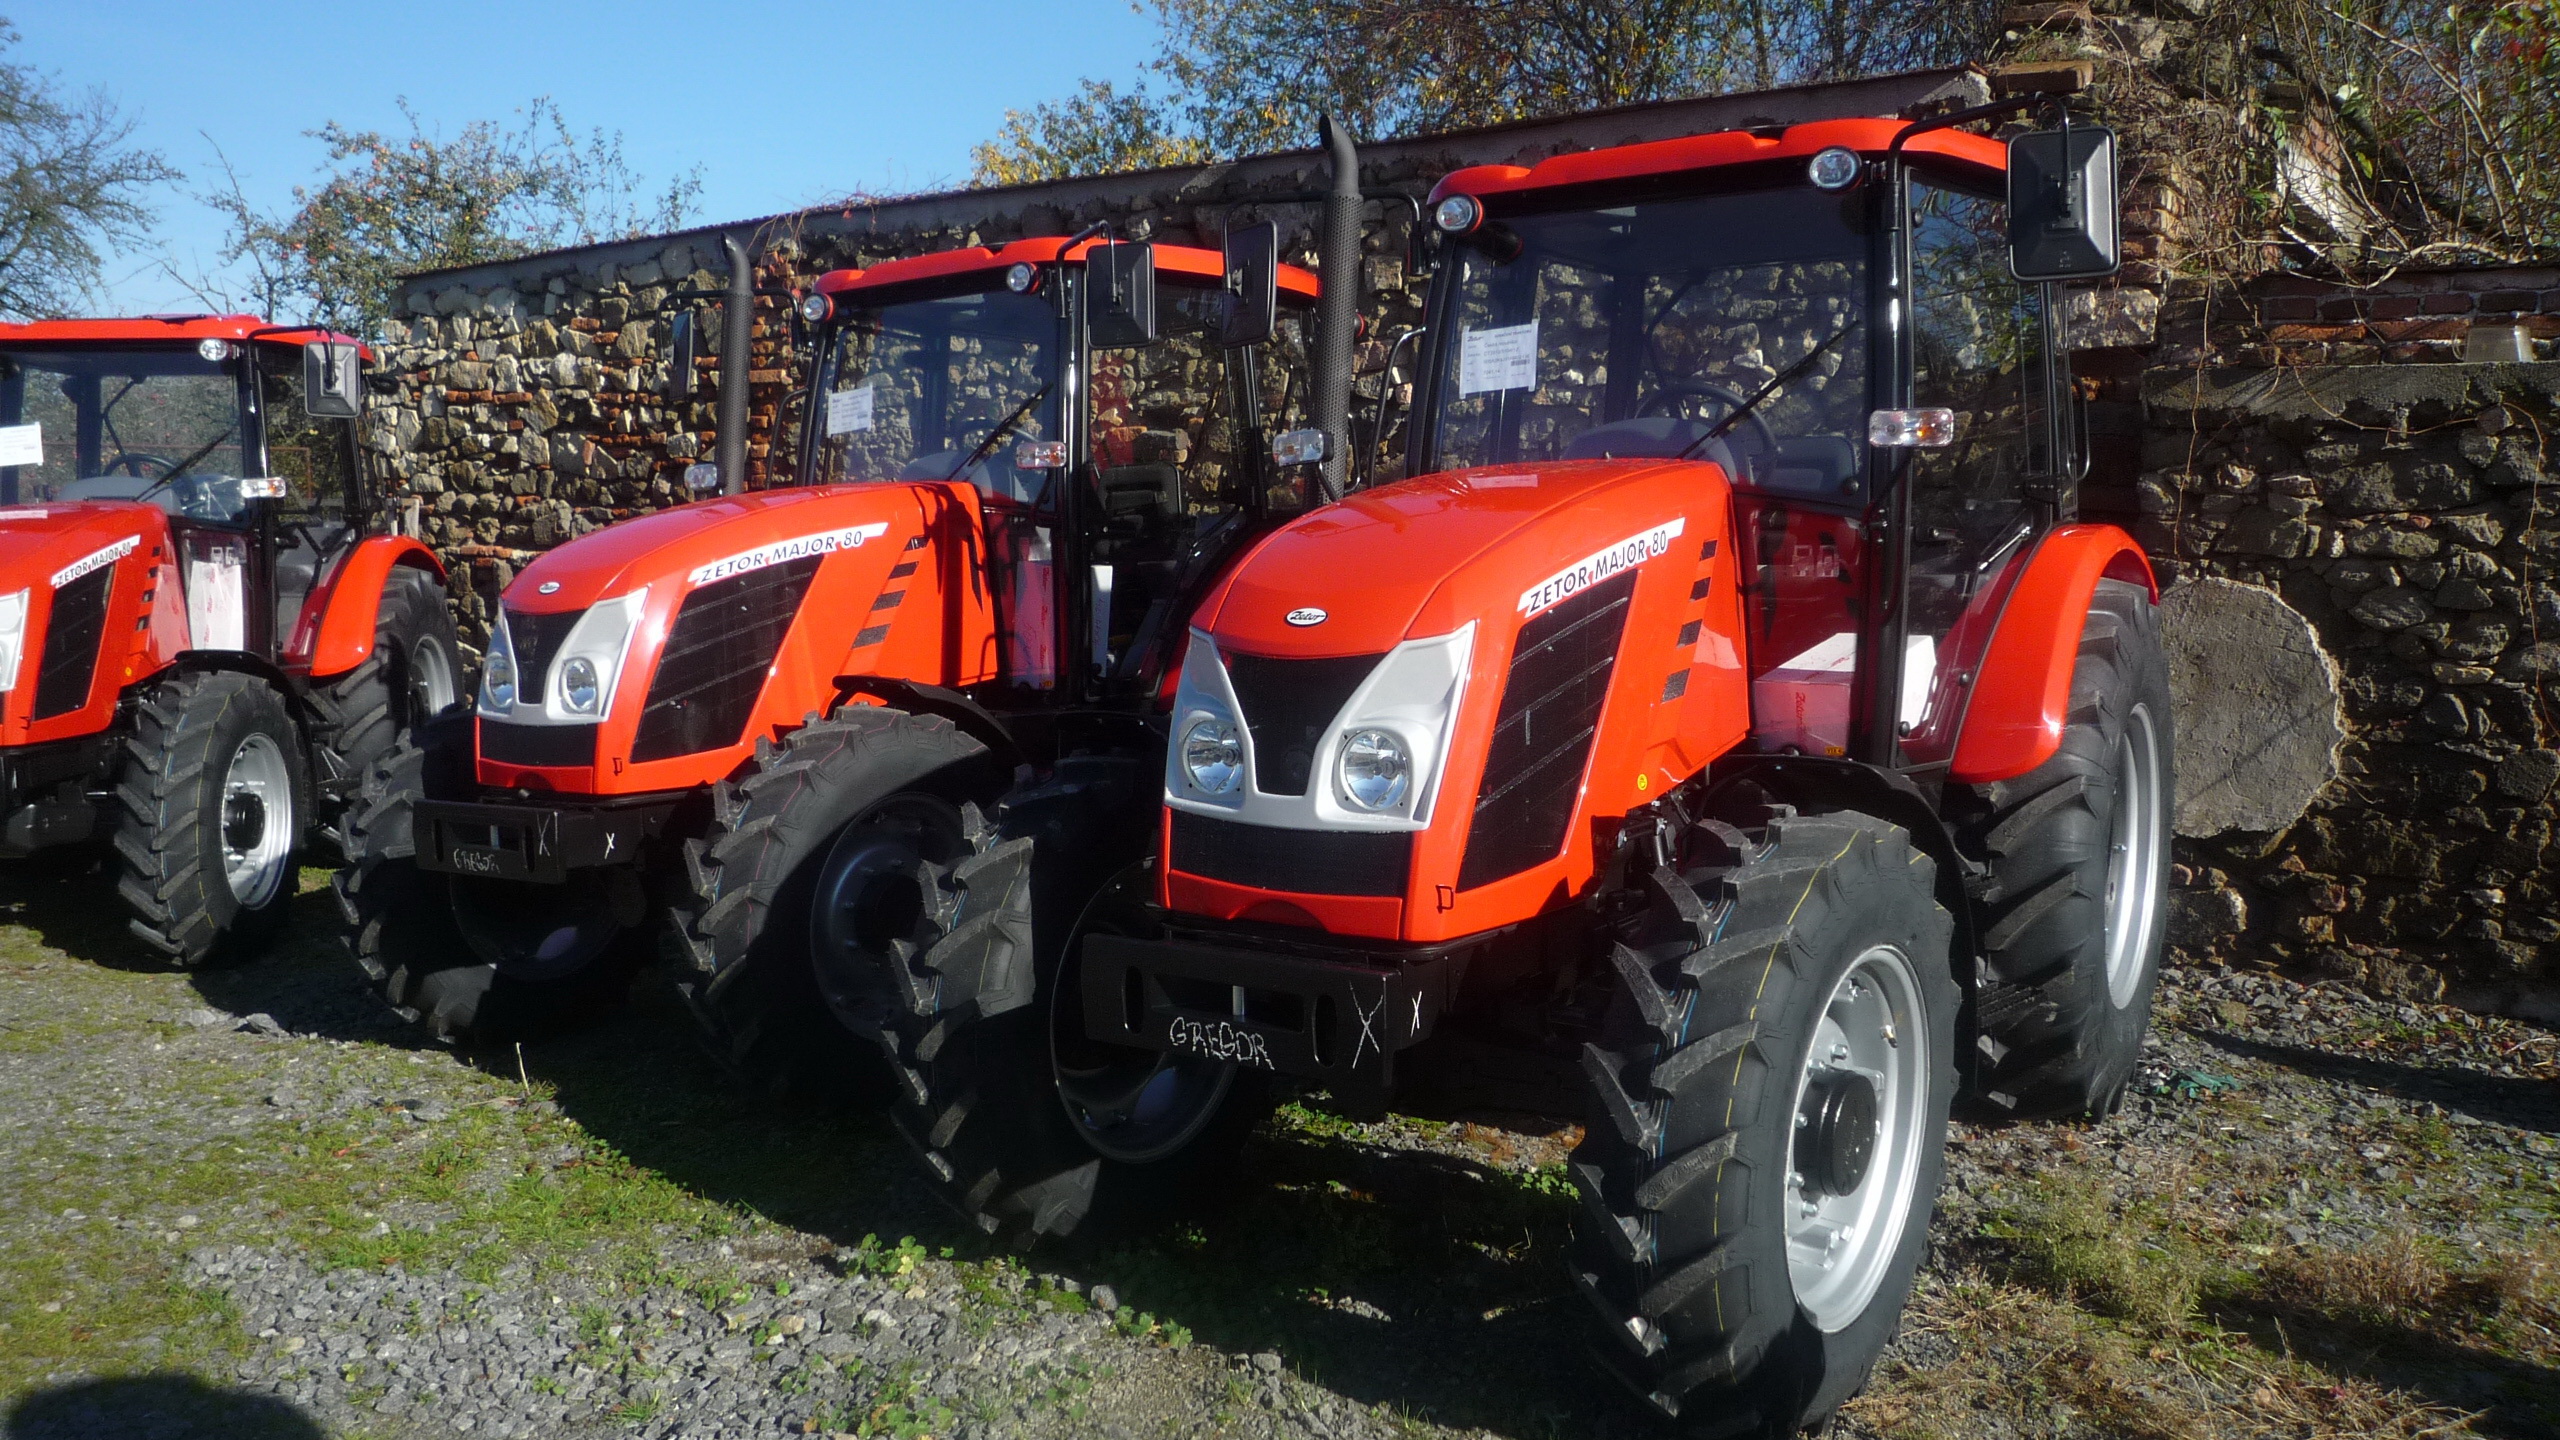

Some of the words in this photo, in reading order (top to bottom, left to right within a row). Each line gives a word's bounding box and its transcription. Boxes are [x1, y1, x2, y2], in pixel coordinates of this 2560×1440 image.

[57, 562, 88, 586] ZETOR
[91, 547, 119, 567] MAJOR
[122, 541, 131, 554] 80
[701, 552, 764, 582] ZETOR
[773, 536, 835, 562] MAJOR
[843, 530, 862, 547] 80
[1530, 567, 1587, 613] ZETOR
[1594, 539, 1645, 580] MAJOR
[1652, 529, 1667, 554] 80
[1169, 1016, 1275, 1071] GREGOR
